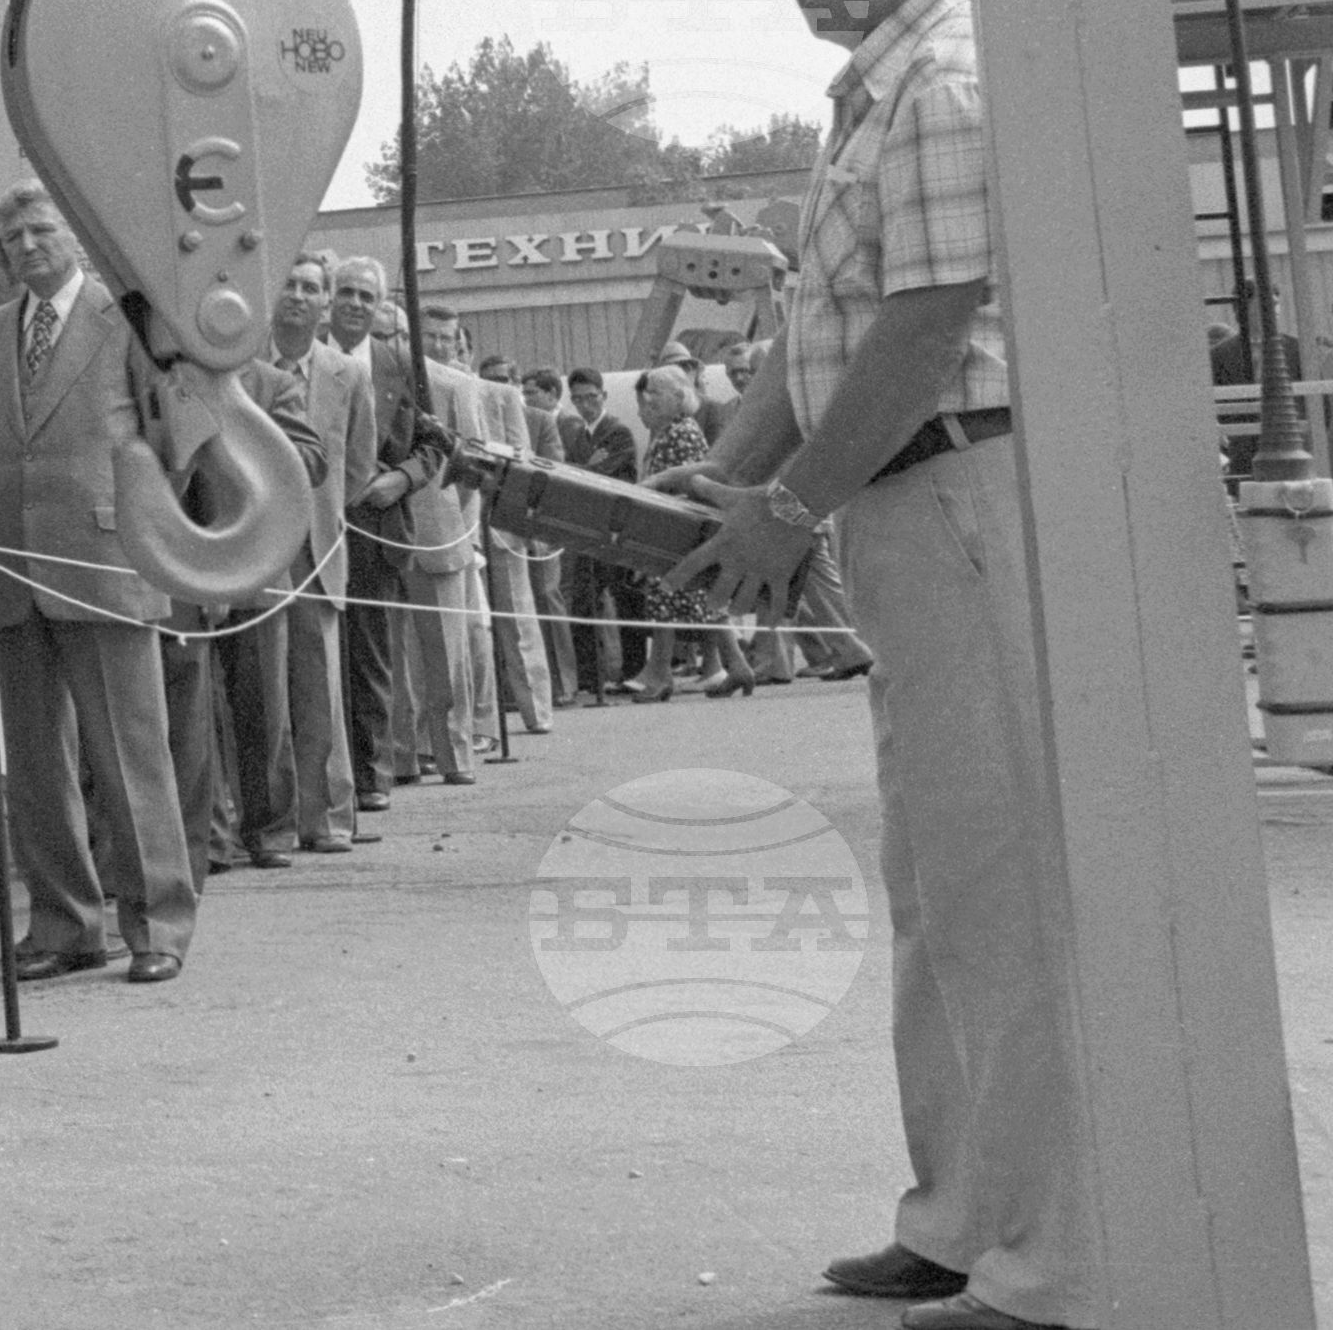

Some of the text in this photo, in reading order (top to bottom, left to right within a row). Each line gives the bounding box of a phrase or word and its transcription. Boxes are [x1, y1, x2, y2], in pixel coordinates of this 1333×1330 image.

[293, 27, 328, 44] NEU
[280, 40, 346, 62] НОВО
[294, 60, 332, 75] NEW
[415, 223, 710, 273] ТЕХНИ
